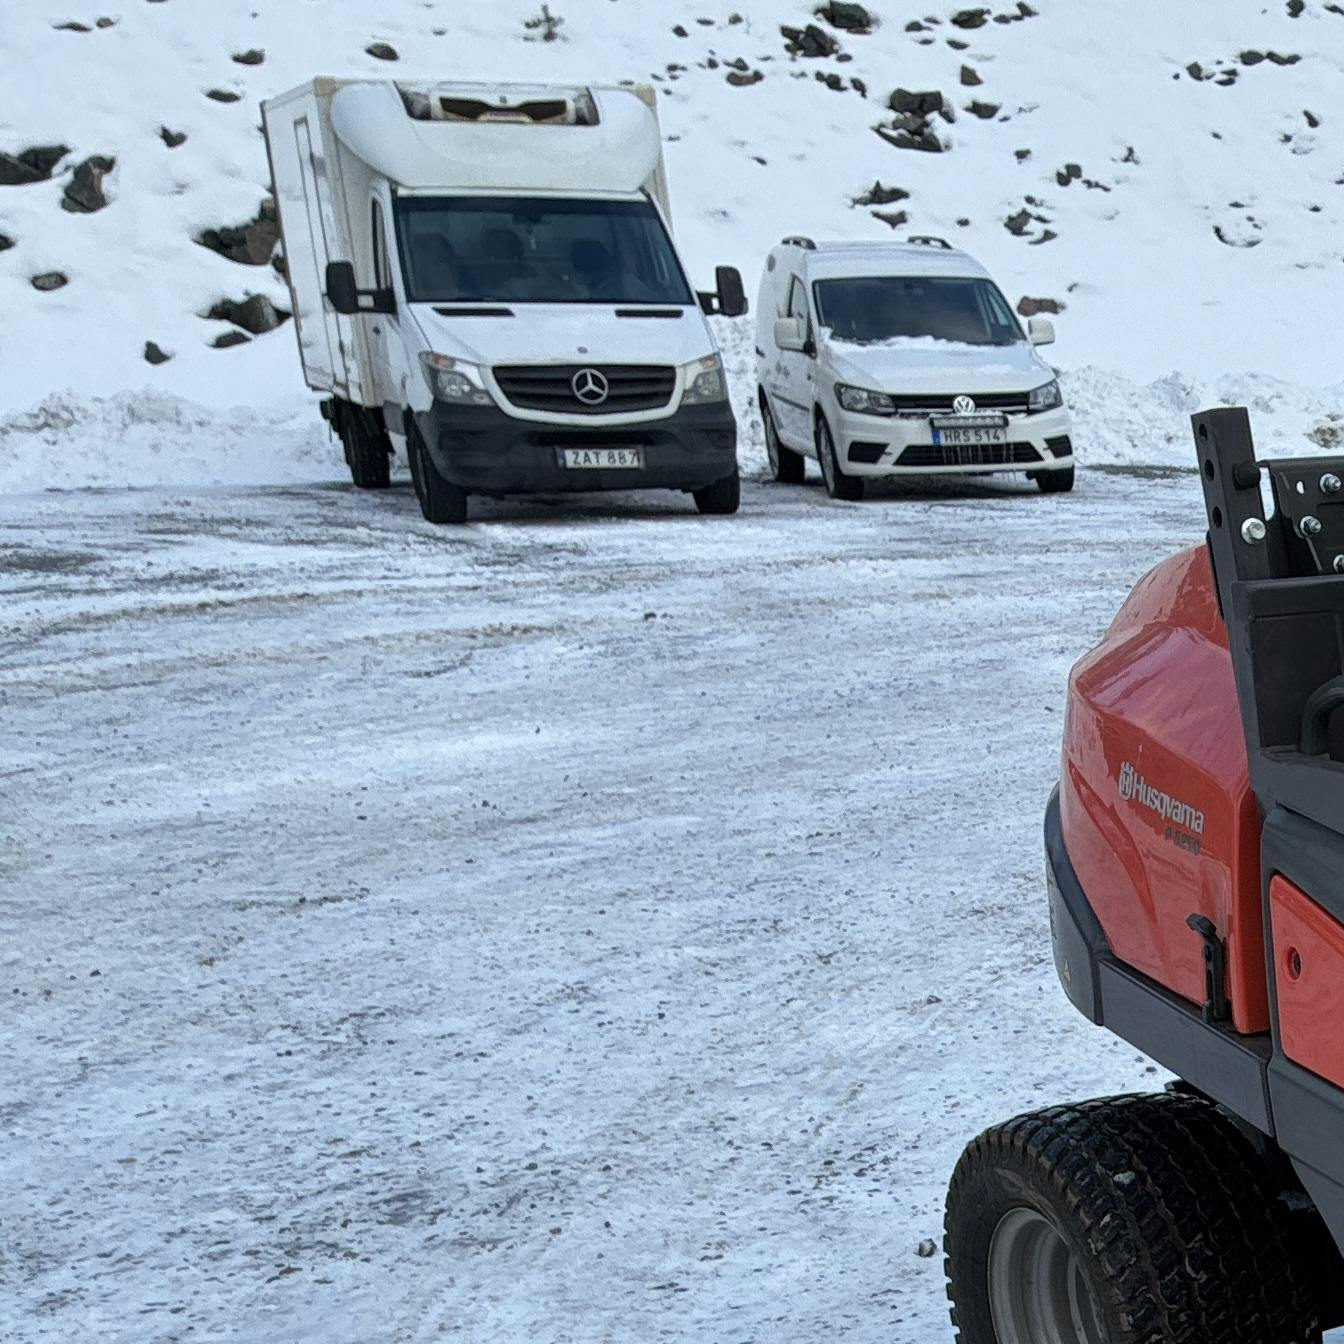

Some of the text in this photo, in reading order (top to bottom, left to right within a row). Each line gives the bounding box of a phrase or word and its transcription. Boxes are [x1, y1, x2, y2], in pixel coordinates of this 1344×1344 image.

[943, 428, 1000, 442] HRS 514
[572, 450, 640, 465] ZAT 887
[1132, 773, 1204, 833] Husqvarna
